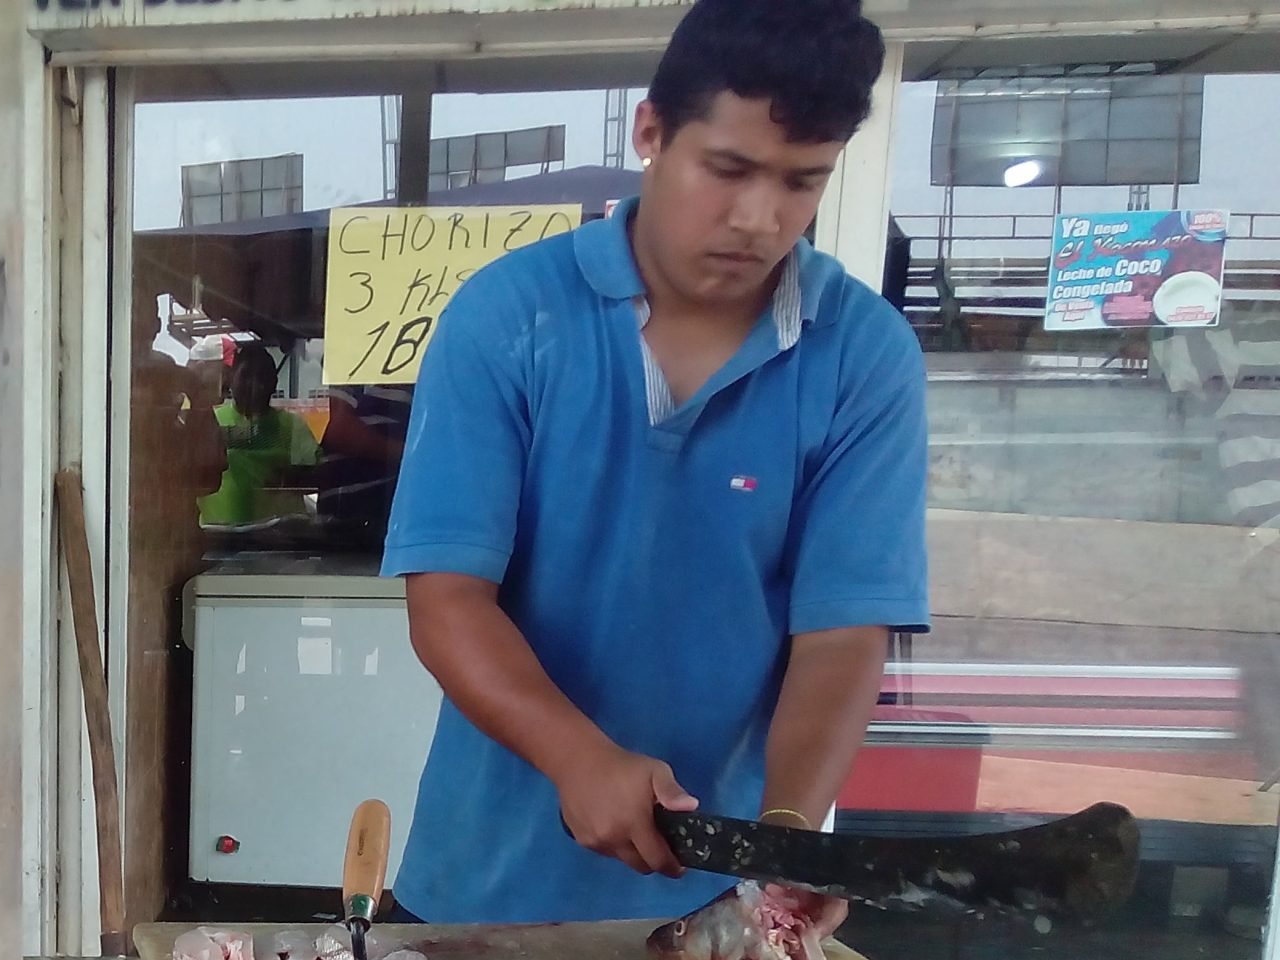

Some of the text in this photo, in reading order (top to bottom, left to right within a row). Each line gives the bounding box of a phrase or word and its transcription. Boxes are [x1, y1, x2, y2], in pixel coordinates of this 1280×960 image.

[1061, 218, 1090, 238] Ya
[1057, 259, 1162, 283] Leche de Coco
[343, 272, 374, 314] 3
[1052, 280, 1134, 300] Congelada
